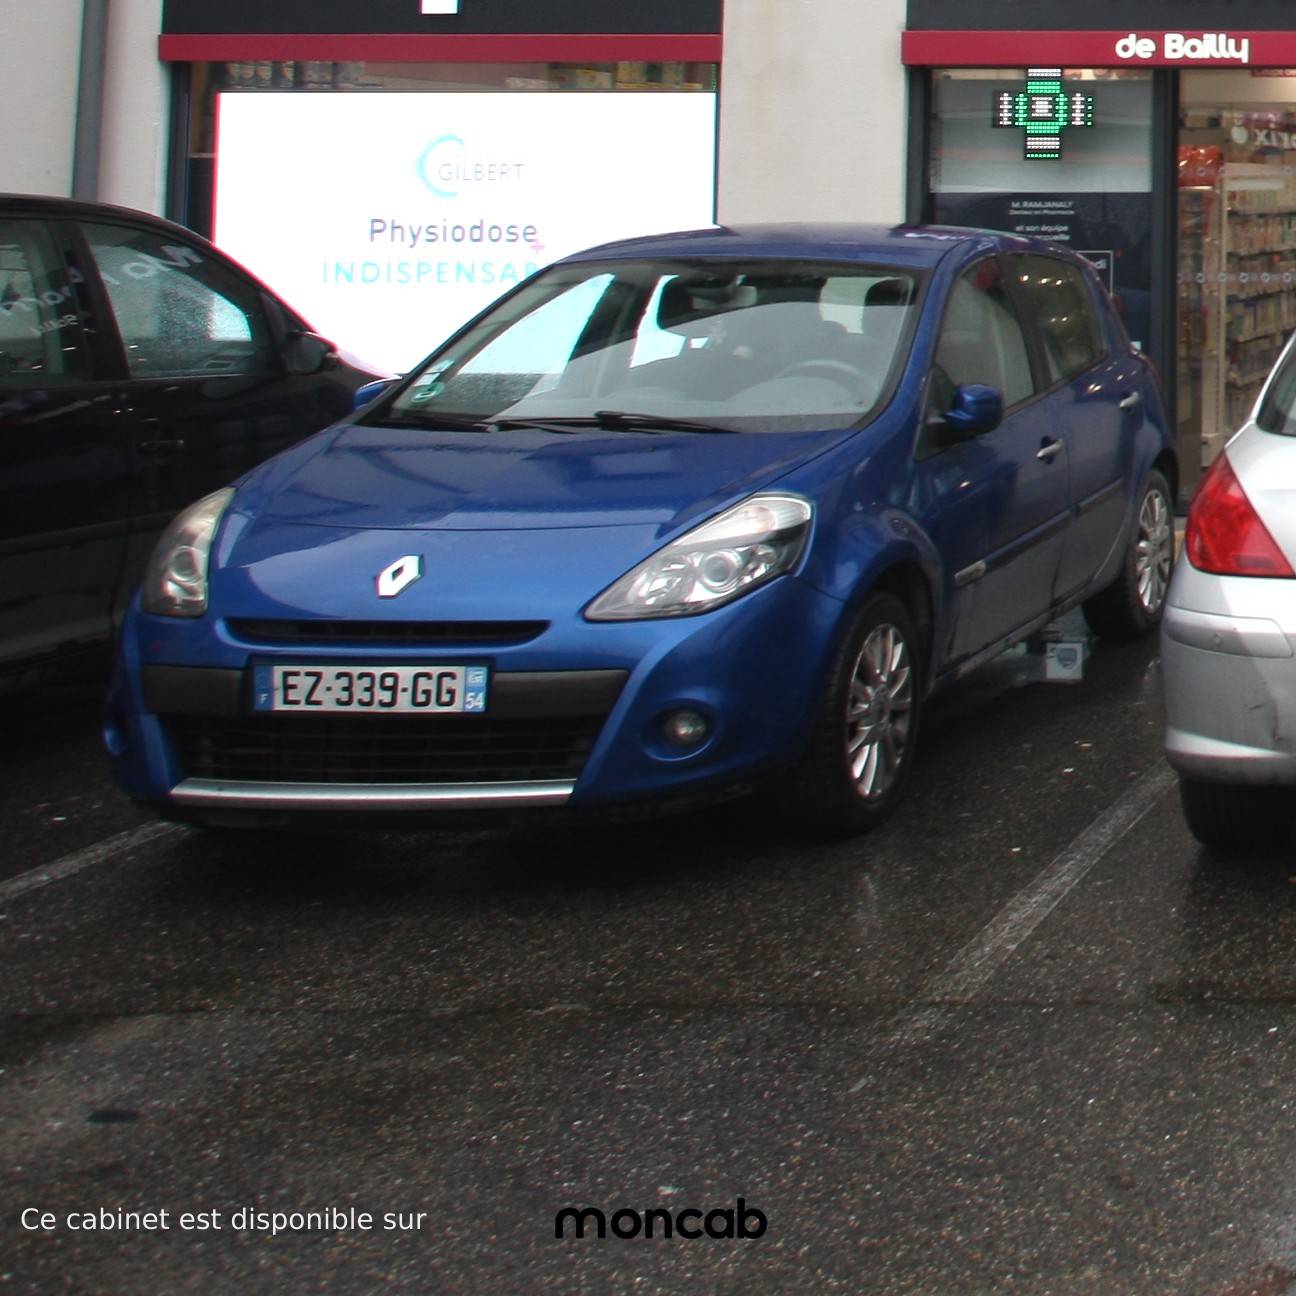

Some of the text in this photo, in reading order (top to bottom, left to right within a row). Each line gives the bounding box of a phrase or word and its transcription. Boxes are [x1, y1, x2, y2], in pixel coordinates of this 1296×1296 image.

[1115, 34, 1249, 63] de Bailly
[438, 163, 525, 181] GILBERT
[370, 218, 538, 248] Physiodose
[281, 670, 457, 707] EZ-339-GG
[465, 692, 484, 710] 54
